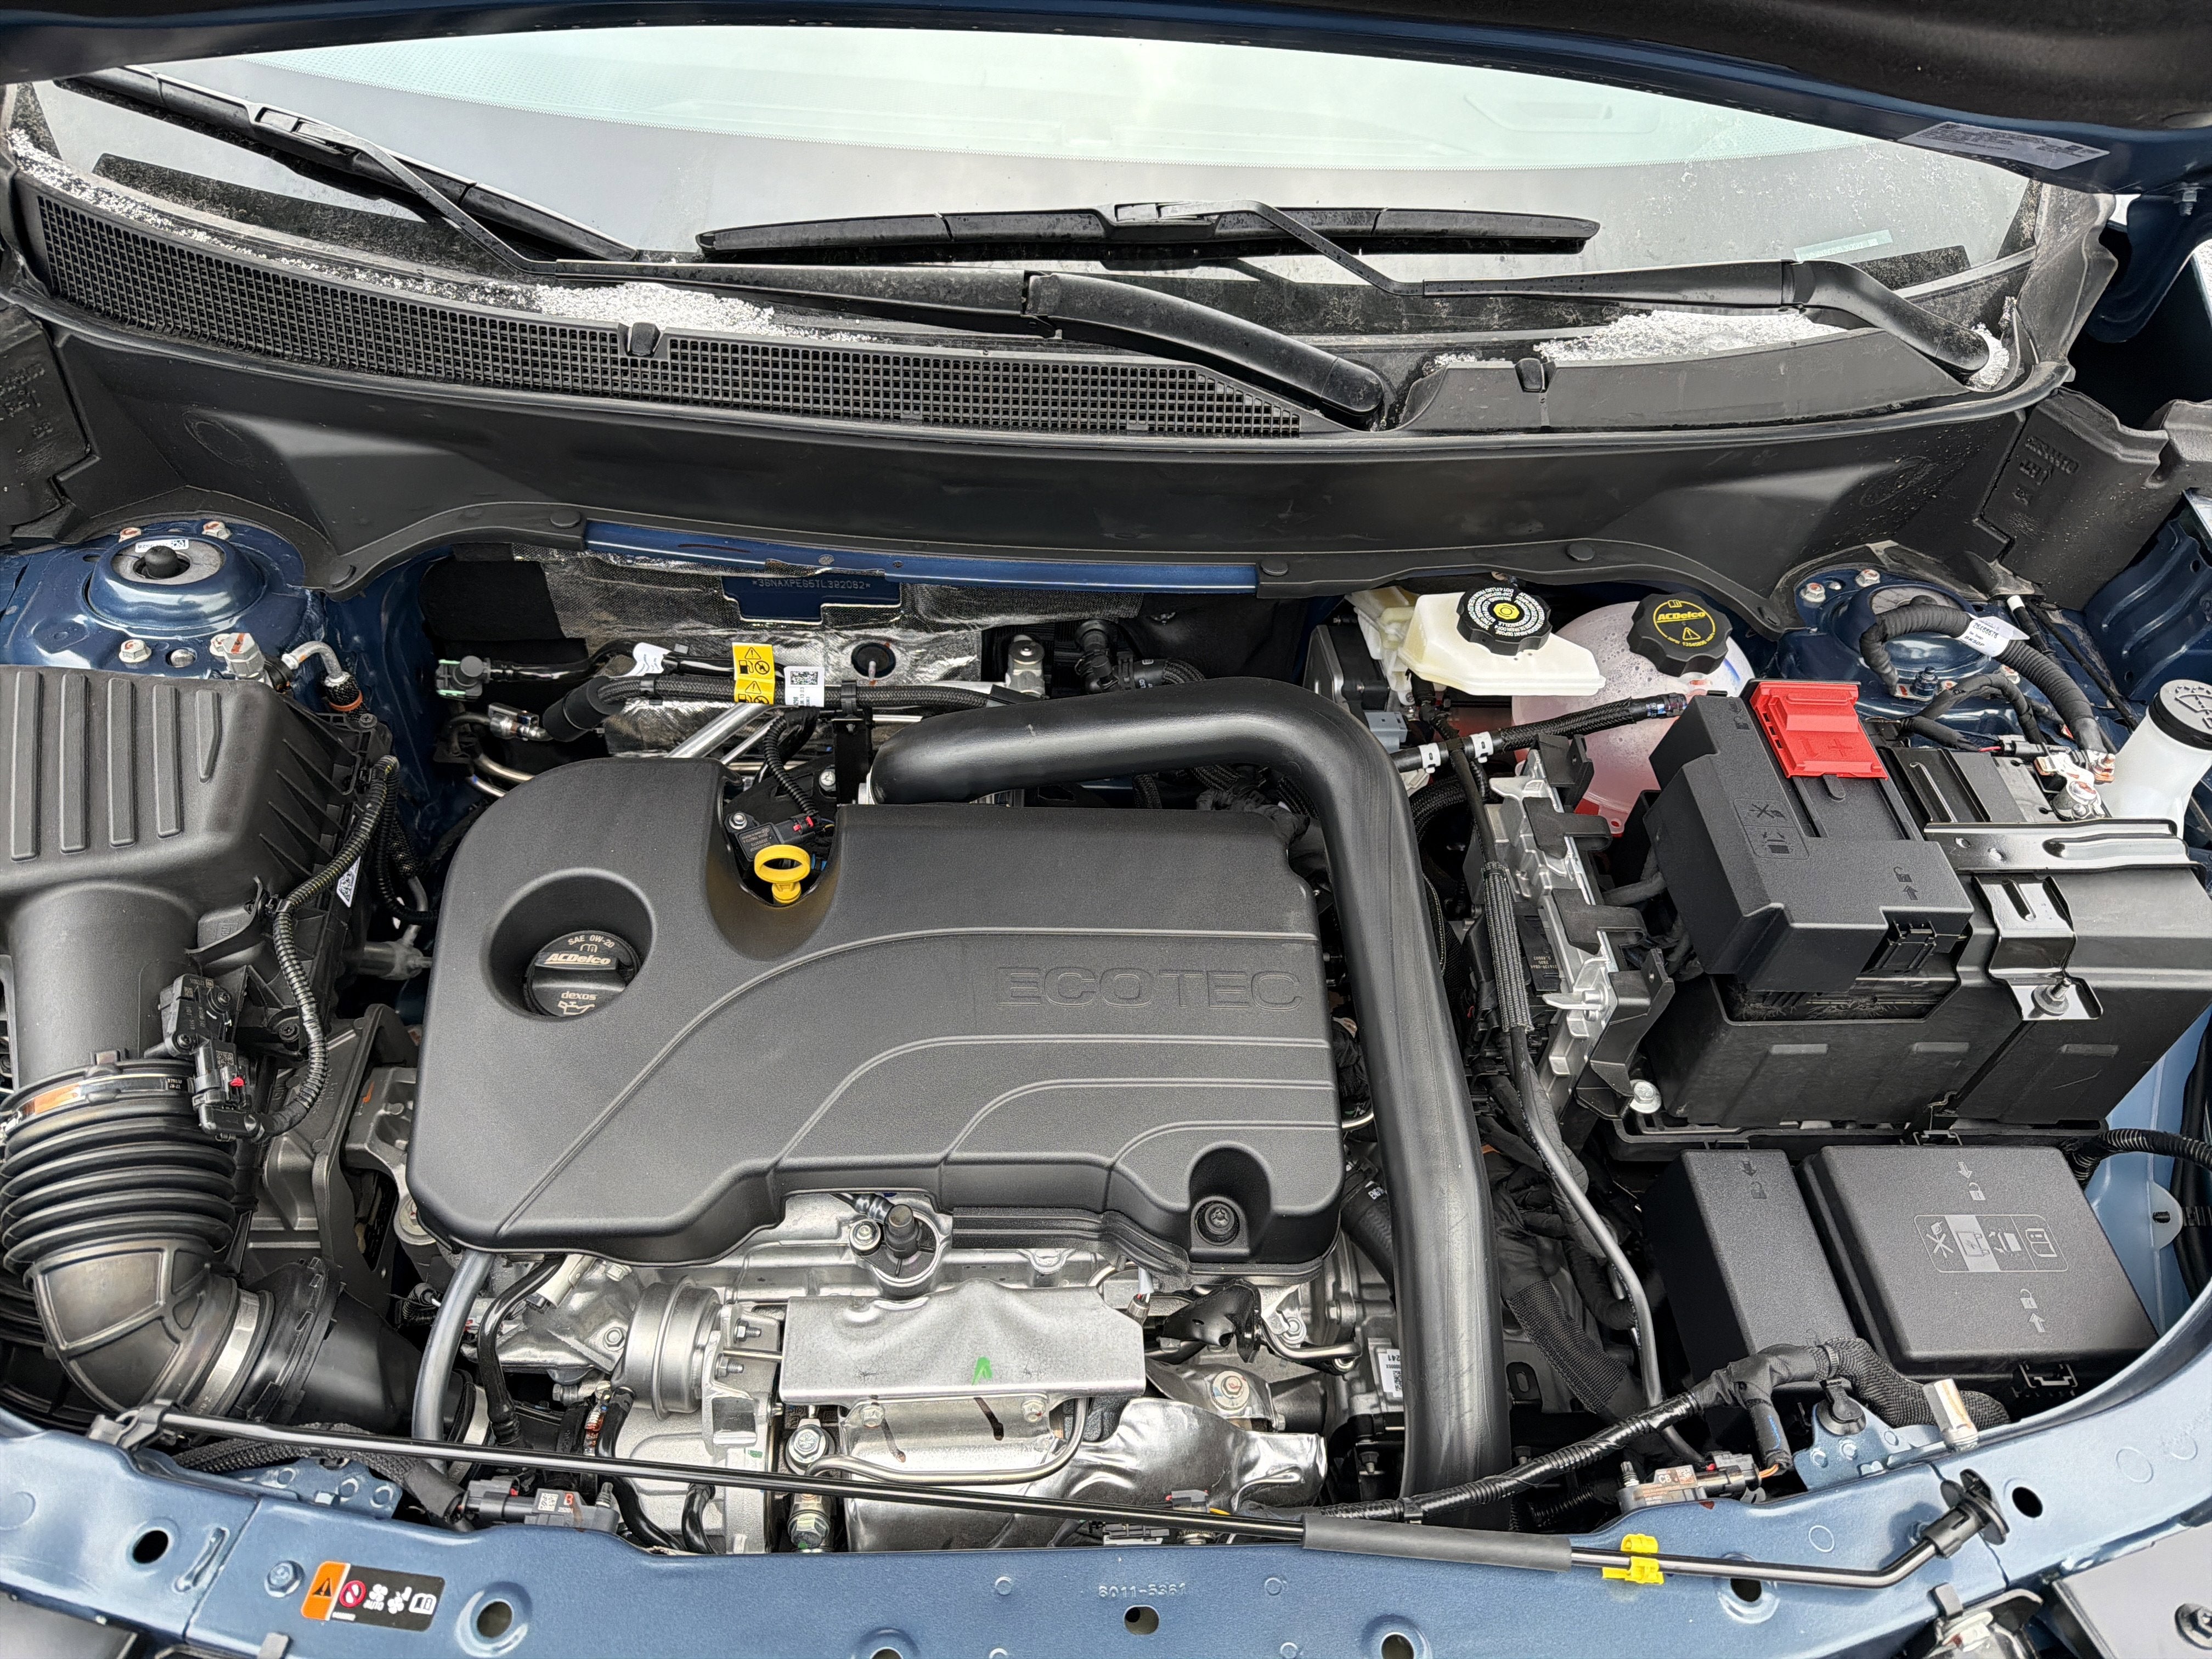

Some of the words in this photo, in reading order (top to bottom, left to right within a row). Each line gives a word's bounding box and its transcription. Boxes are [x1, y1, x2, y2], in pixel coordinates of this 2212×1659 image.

[1657, 611, 1706, 620] ACDelco
[568, 935, 585, 945] SAE
[589, 934, 615, 948] 0W-20
[545, 953, 611, 966] ACDelco
[996, 966, 1302, 1011] ECOTEC
[561, 991, 597, 1001] dexos
[1658, 1474, 1672, 1483] CB
[563, 1492, 574, 1506] B
[363, 1599, 385, 1611] AUTO
